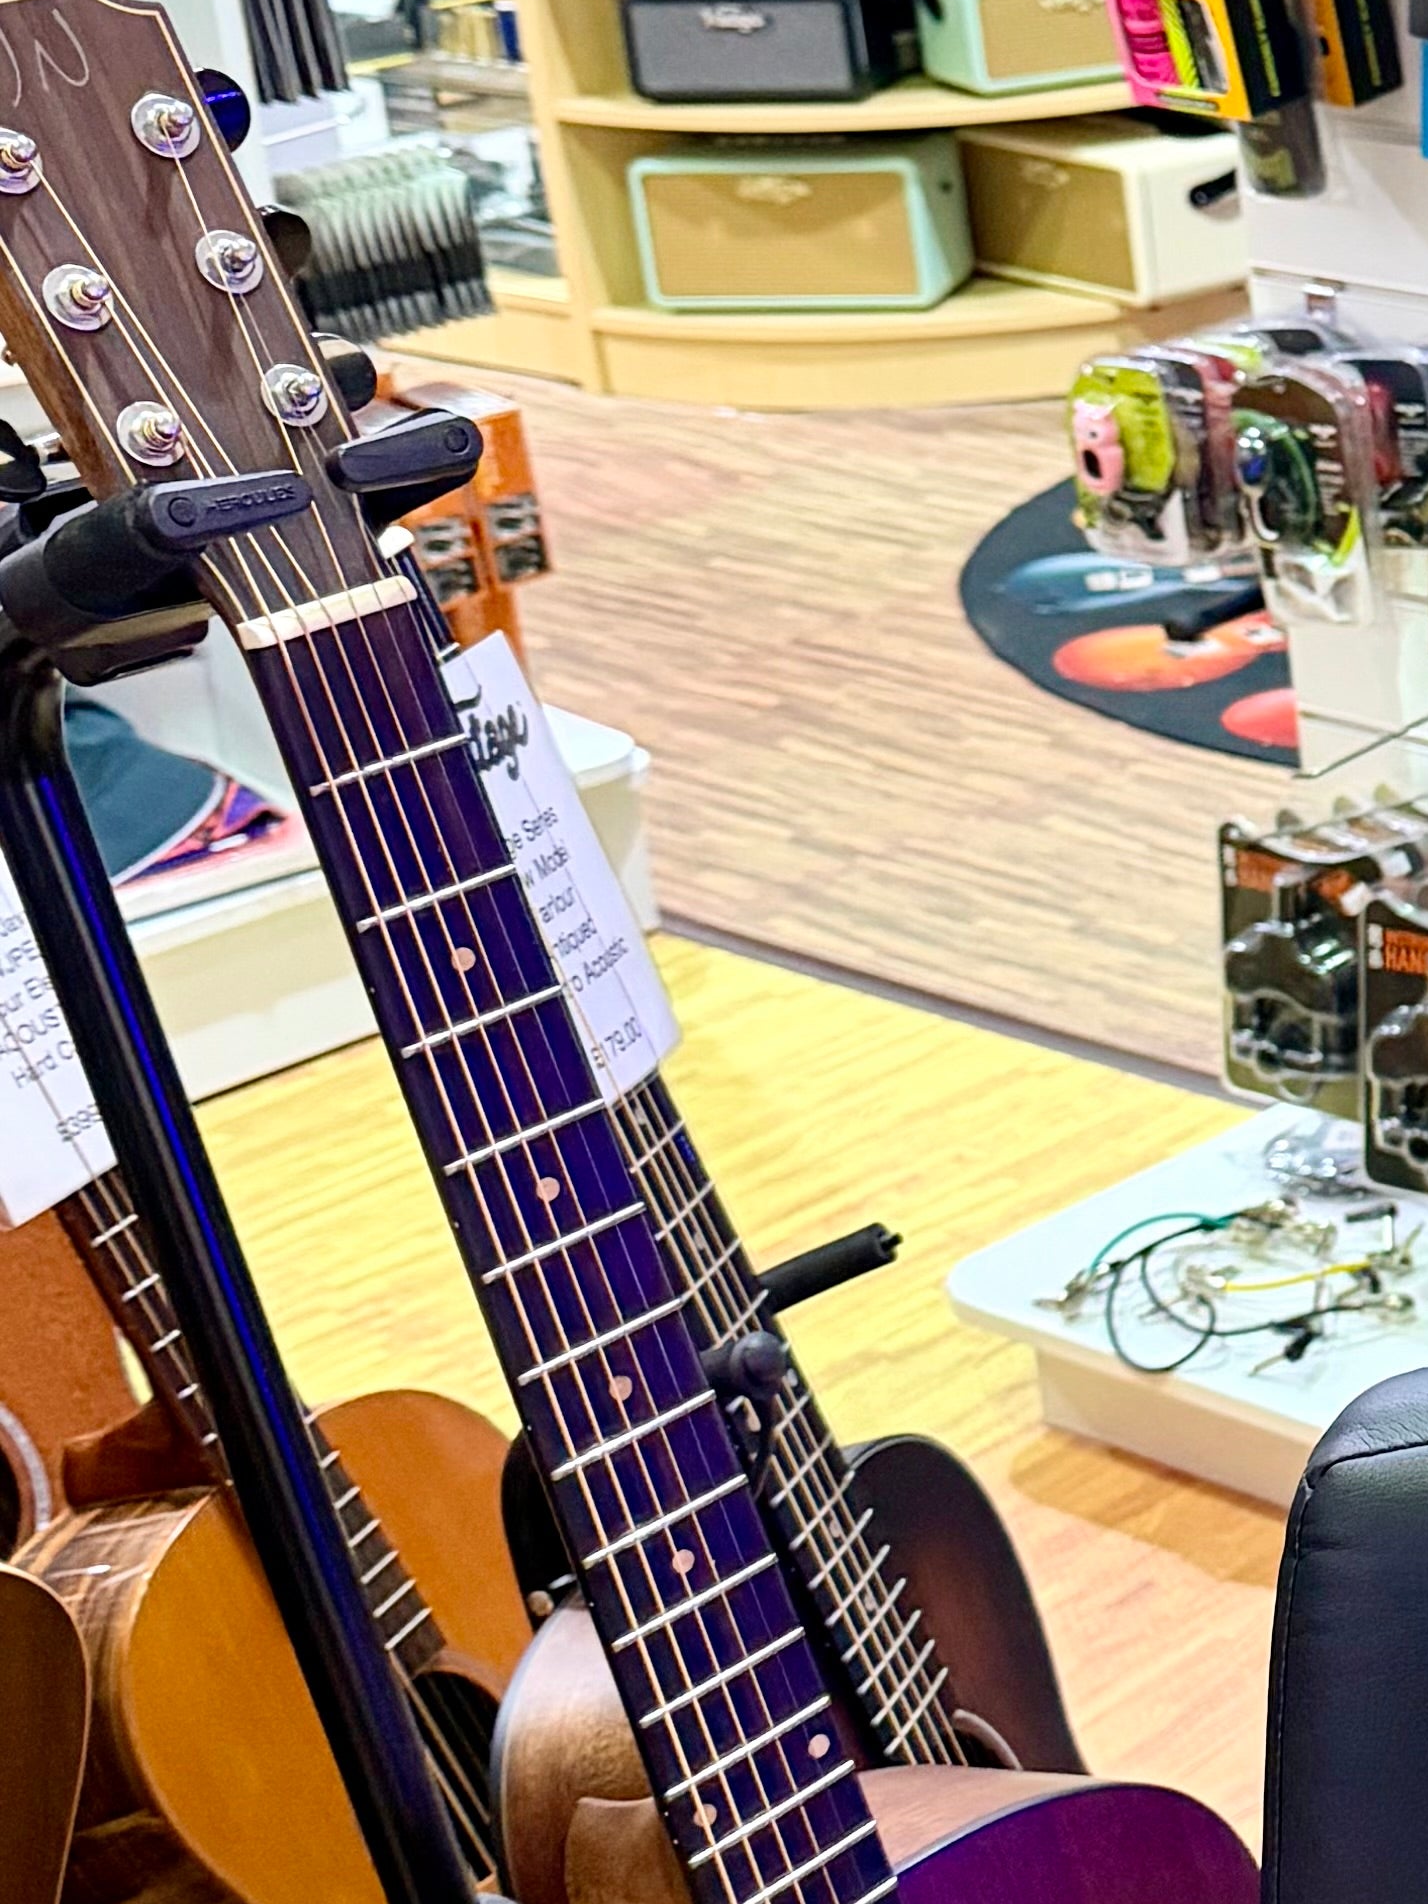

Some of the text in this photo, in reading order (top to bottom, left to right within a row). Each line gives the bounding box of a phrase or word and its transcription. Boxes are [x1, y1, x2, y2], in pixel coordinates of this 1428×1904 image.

[520, 806, 559, 843] Series
[538, 885, 577, 924] arlour
[583, 936, 631, 985] Acoustic
